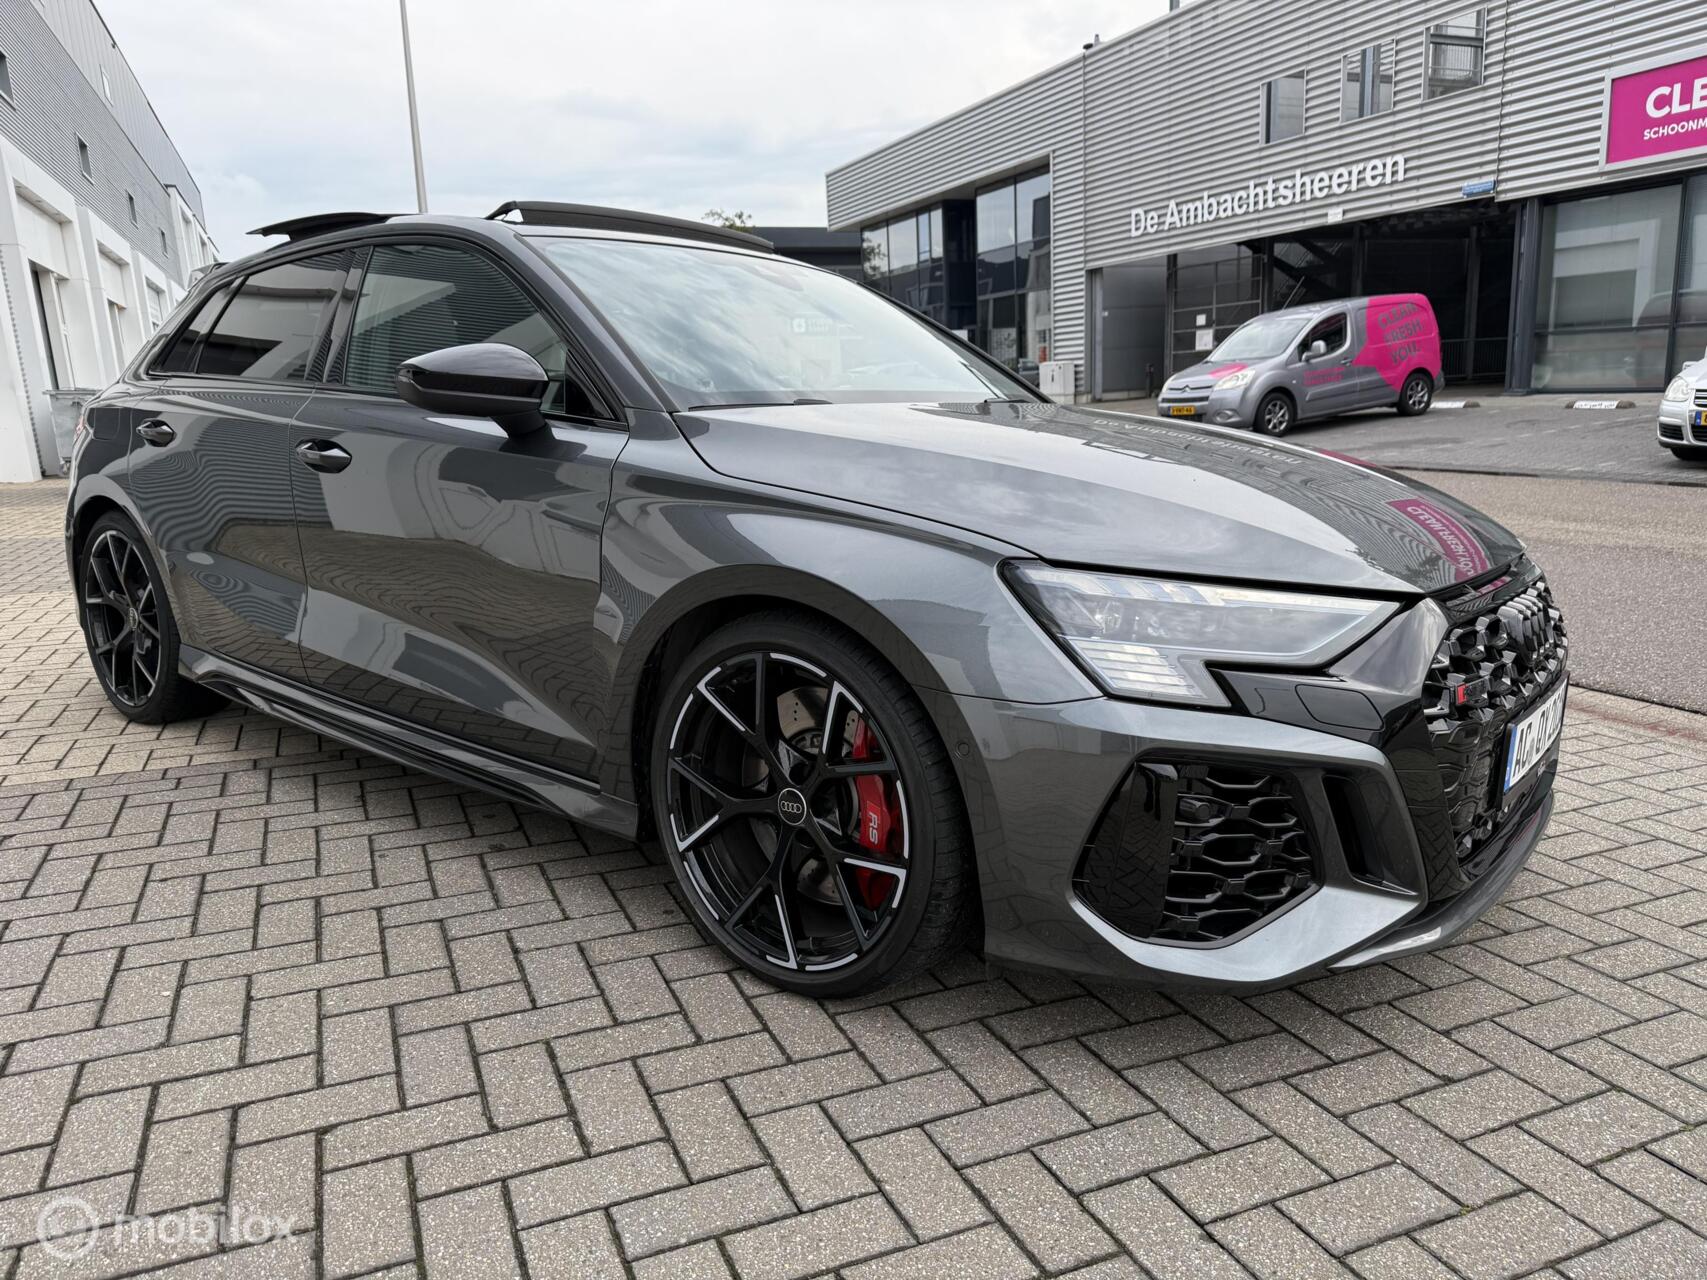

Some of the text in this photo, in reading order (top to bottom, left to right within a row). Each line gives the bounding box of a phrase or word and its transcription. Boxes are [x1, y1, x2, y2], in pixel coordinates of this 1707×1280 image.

[1645, 76, 1707, 118] CLE
[1643, 117, 1707, 140] SCHOONM
[1130, 153, 1406, 238] De Ambachtsheeren
[868, 811, 878, 845] RS
